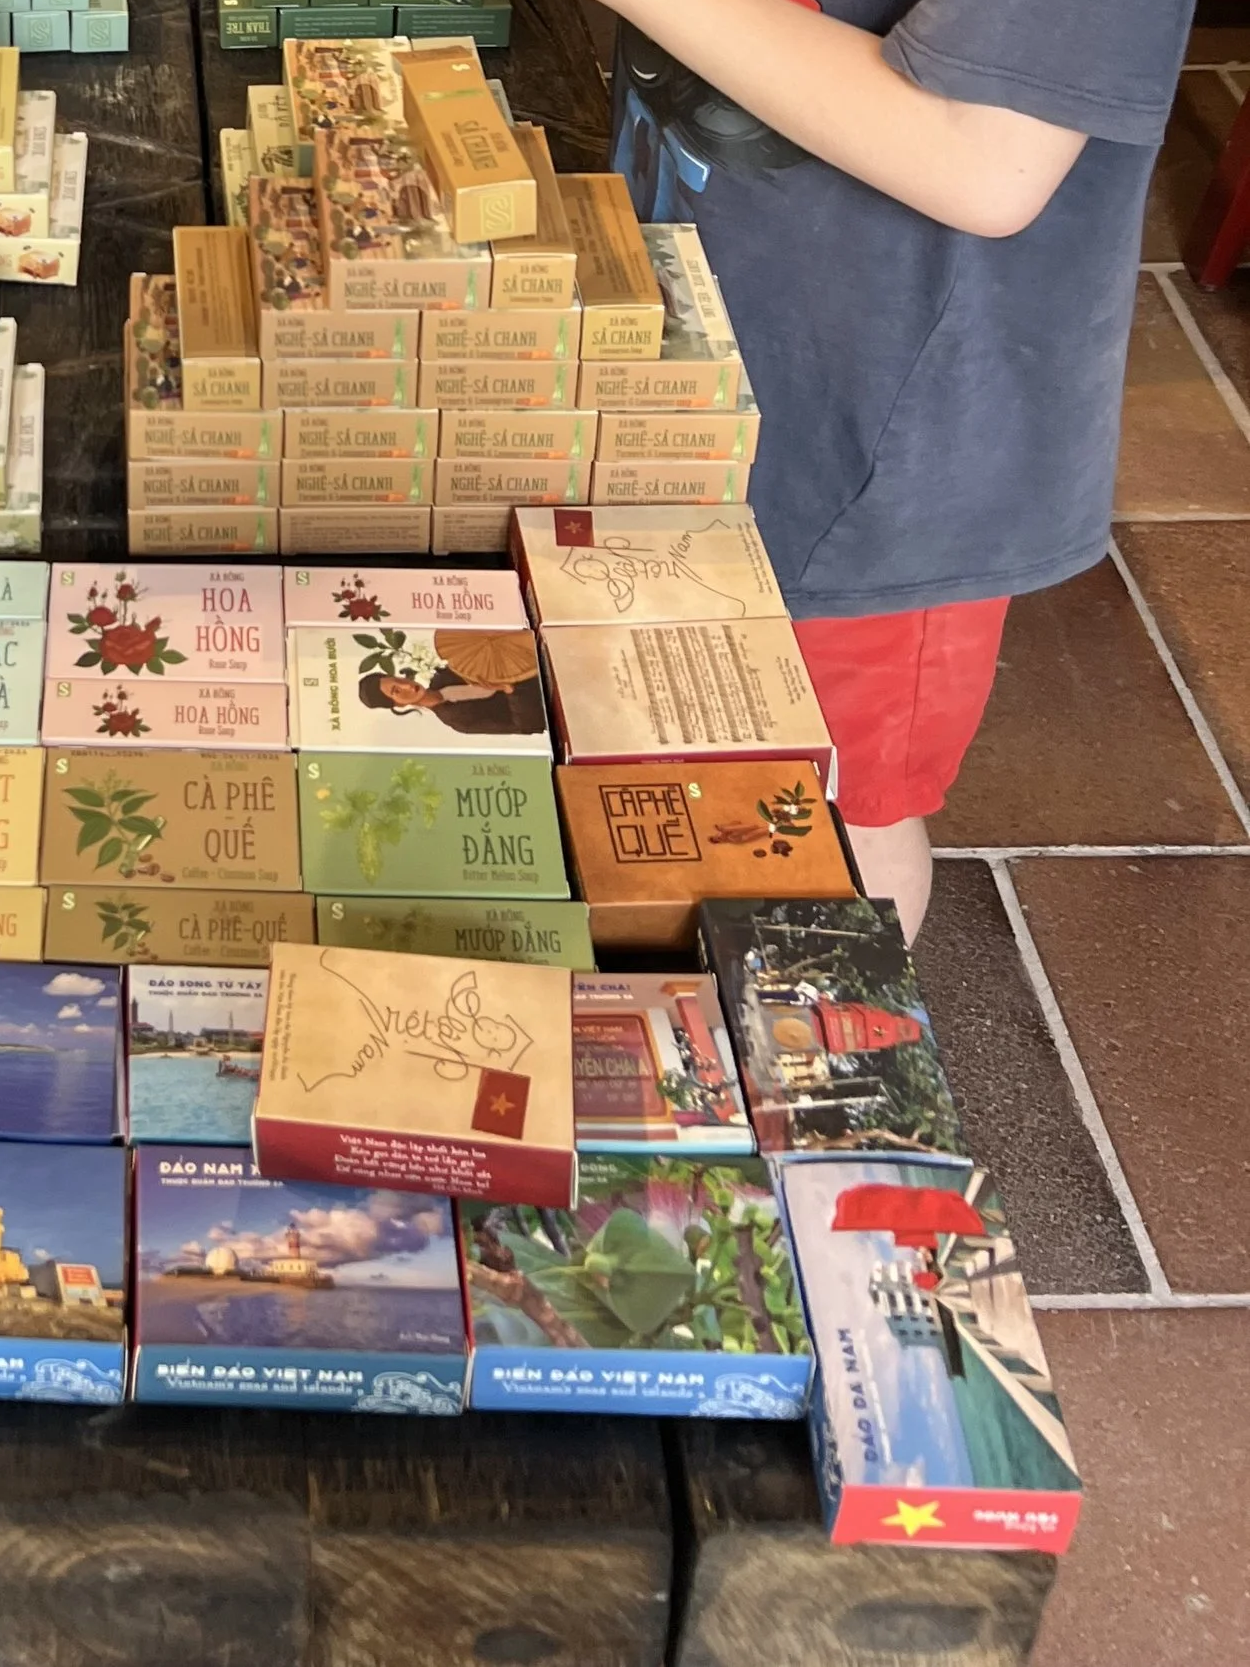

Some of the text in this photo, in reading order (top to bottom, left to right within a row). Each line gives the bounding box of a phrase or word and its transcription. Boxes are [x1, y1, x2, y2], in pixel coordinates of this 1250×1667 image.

[403, 282, 446, 297] CHANH
[524, 278, 563, 294] CHANH
[612, 330, 651, 345] CHANH
[492, 380, 535, 394] CHANH
[512, 432, 554, 447] CHANH
[201, 588, 253, 612] HOA
[412, 586, 494, 611] HOA HỒNG
[195, 615, 260, 652] HỒNG
[209, 659, 247, 671] Rose Soap
[327, 658, 339, 683] HOA
[175, 699, 260, 725] HOA HỒNG
[183, 774, 276, 811] CÀ PHÊ
[455, 781, 528, 818] MƯỚP
[204, 817, 256, 863] QUẾ
[463, 821, 535, 866] ĐẮNG
[258, 869, 279, 882] Soap
[517, 869, 539, 883] Soap
[178, 912, 288, 942] CÀ PHÊ-QUẾ
[454, 922, 562, 954] MƯỚP ĐẮNG
[178, 980, 213, 989] SONG
[203, 1162, 244, 1176] NAM
[837, 1327, 861, 1373] NAM
[656, 1372, 706, 1386] NAM
